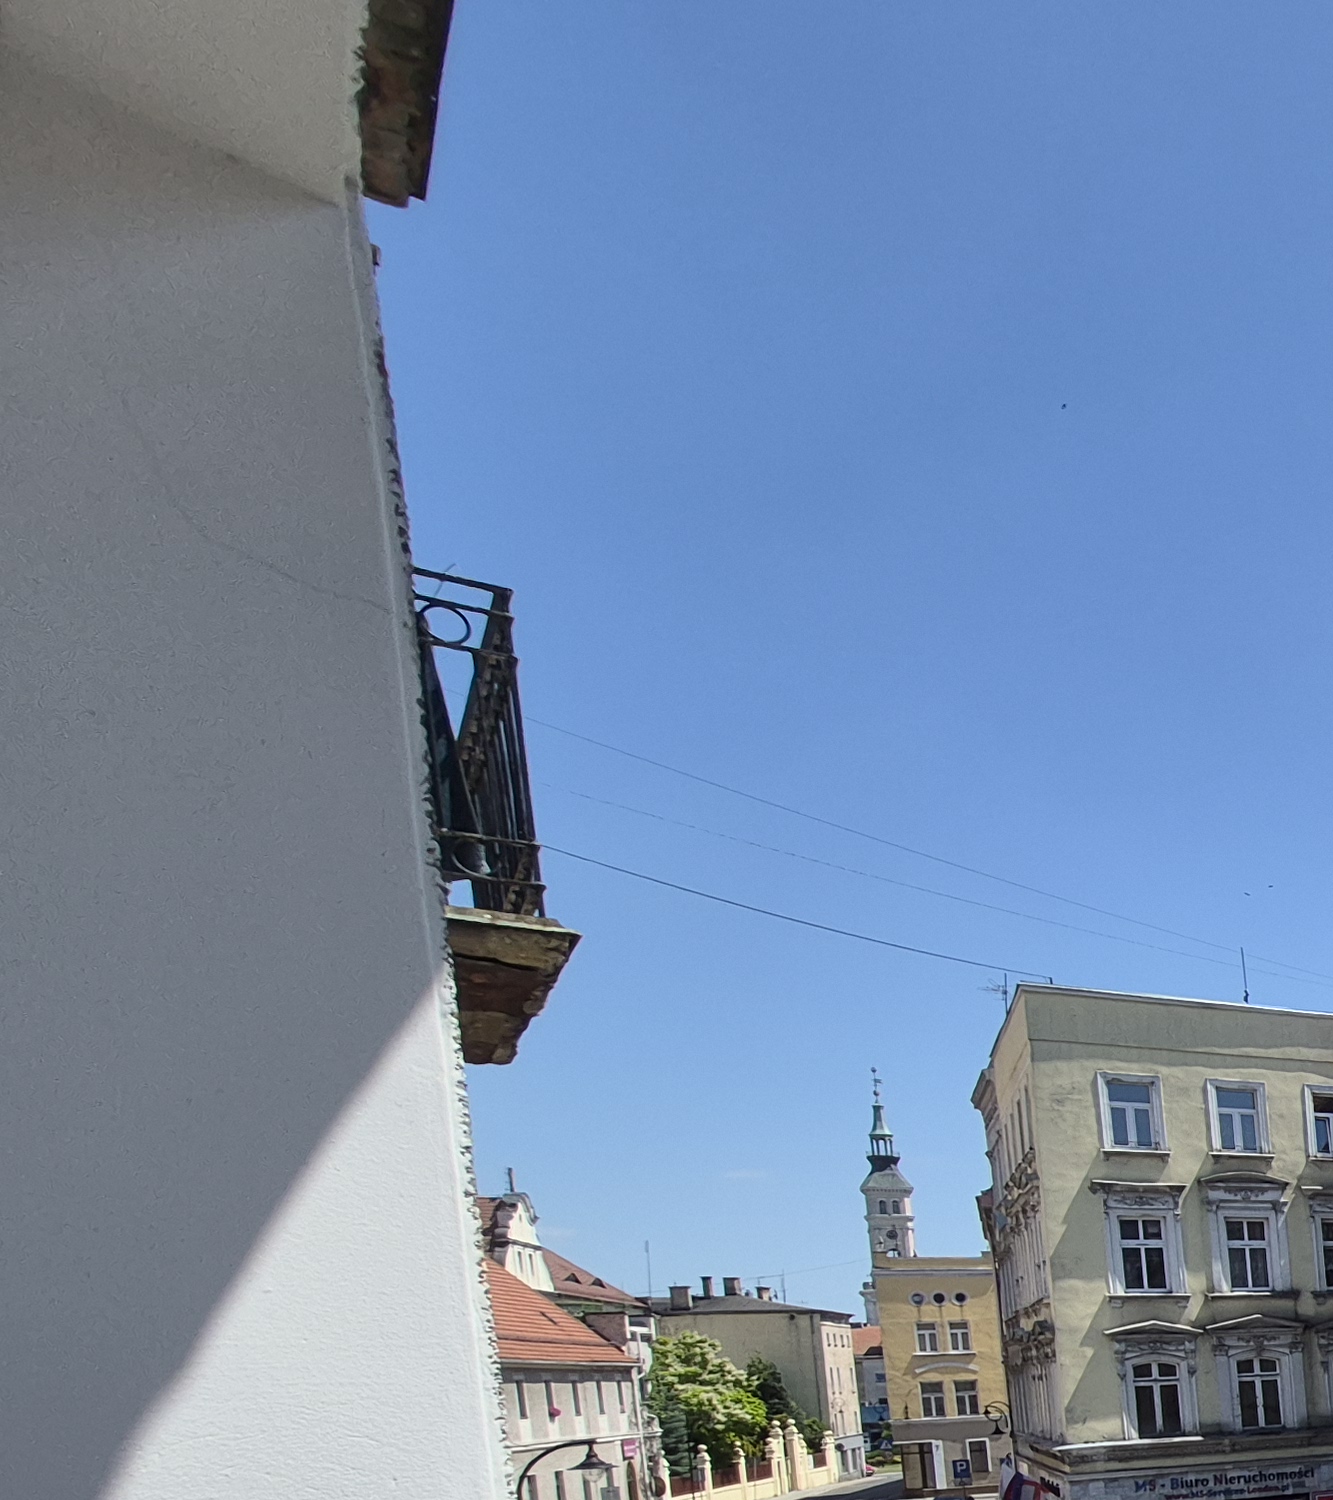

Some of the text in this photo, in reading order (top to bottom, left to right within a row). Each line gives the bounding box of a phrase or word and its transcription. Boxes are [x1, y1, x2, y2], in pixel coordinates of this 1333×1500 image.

[956, 1461, 967, 1473] P
[1134, 1479, 1156, 1492] MS
[1170, 1477, 1209, 1490] Biuro
[1213, 1467, 1315, 1486] Nieruchomości
